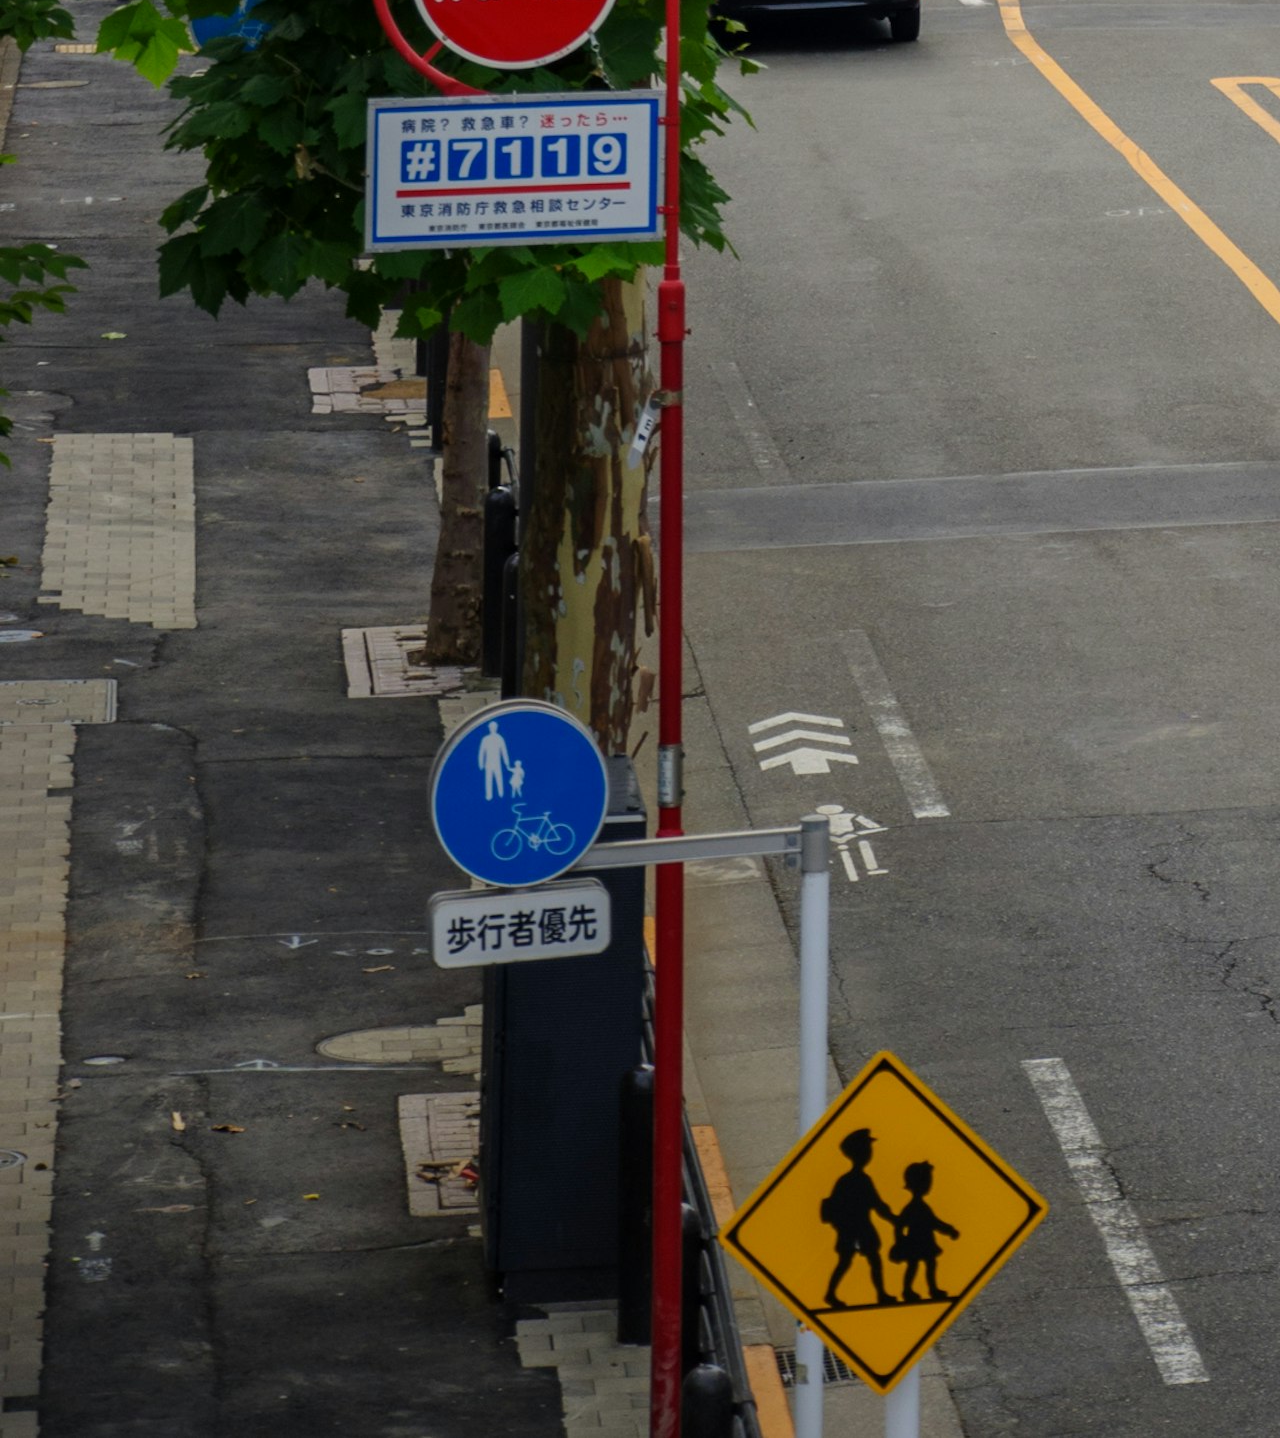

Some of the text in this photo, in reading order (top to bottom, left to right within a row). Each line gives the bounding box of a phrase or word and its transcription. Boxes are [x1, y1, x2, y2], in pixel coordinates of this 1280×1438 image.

[401, 118, 450, 133] 病院？
[461, 115, 529, 131] 救急車？
[405, 135, 623, 181] #7119
[401, 198, 626, 218] 東京消防庁救急相談センター
[447, 904, 598, 954] 歩行者優先
